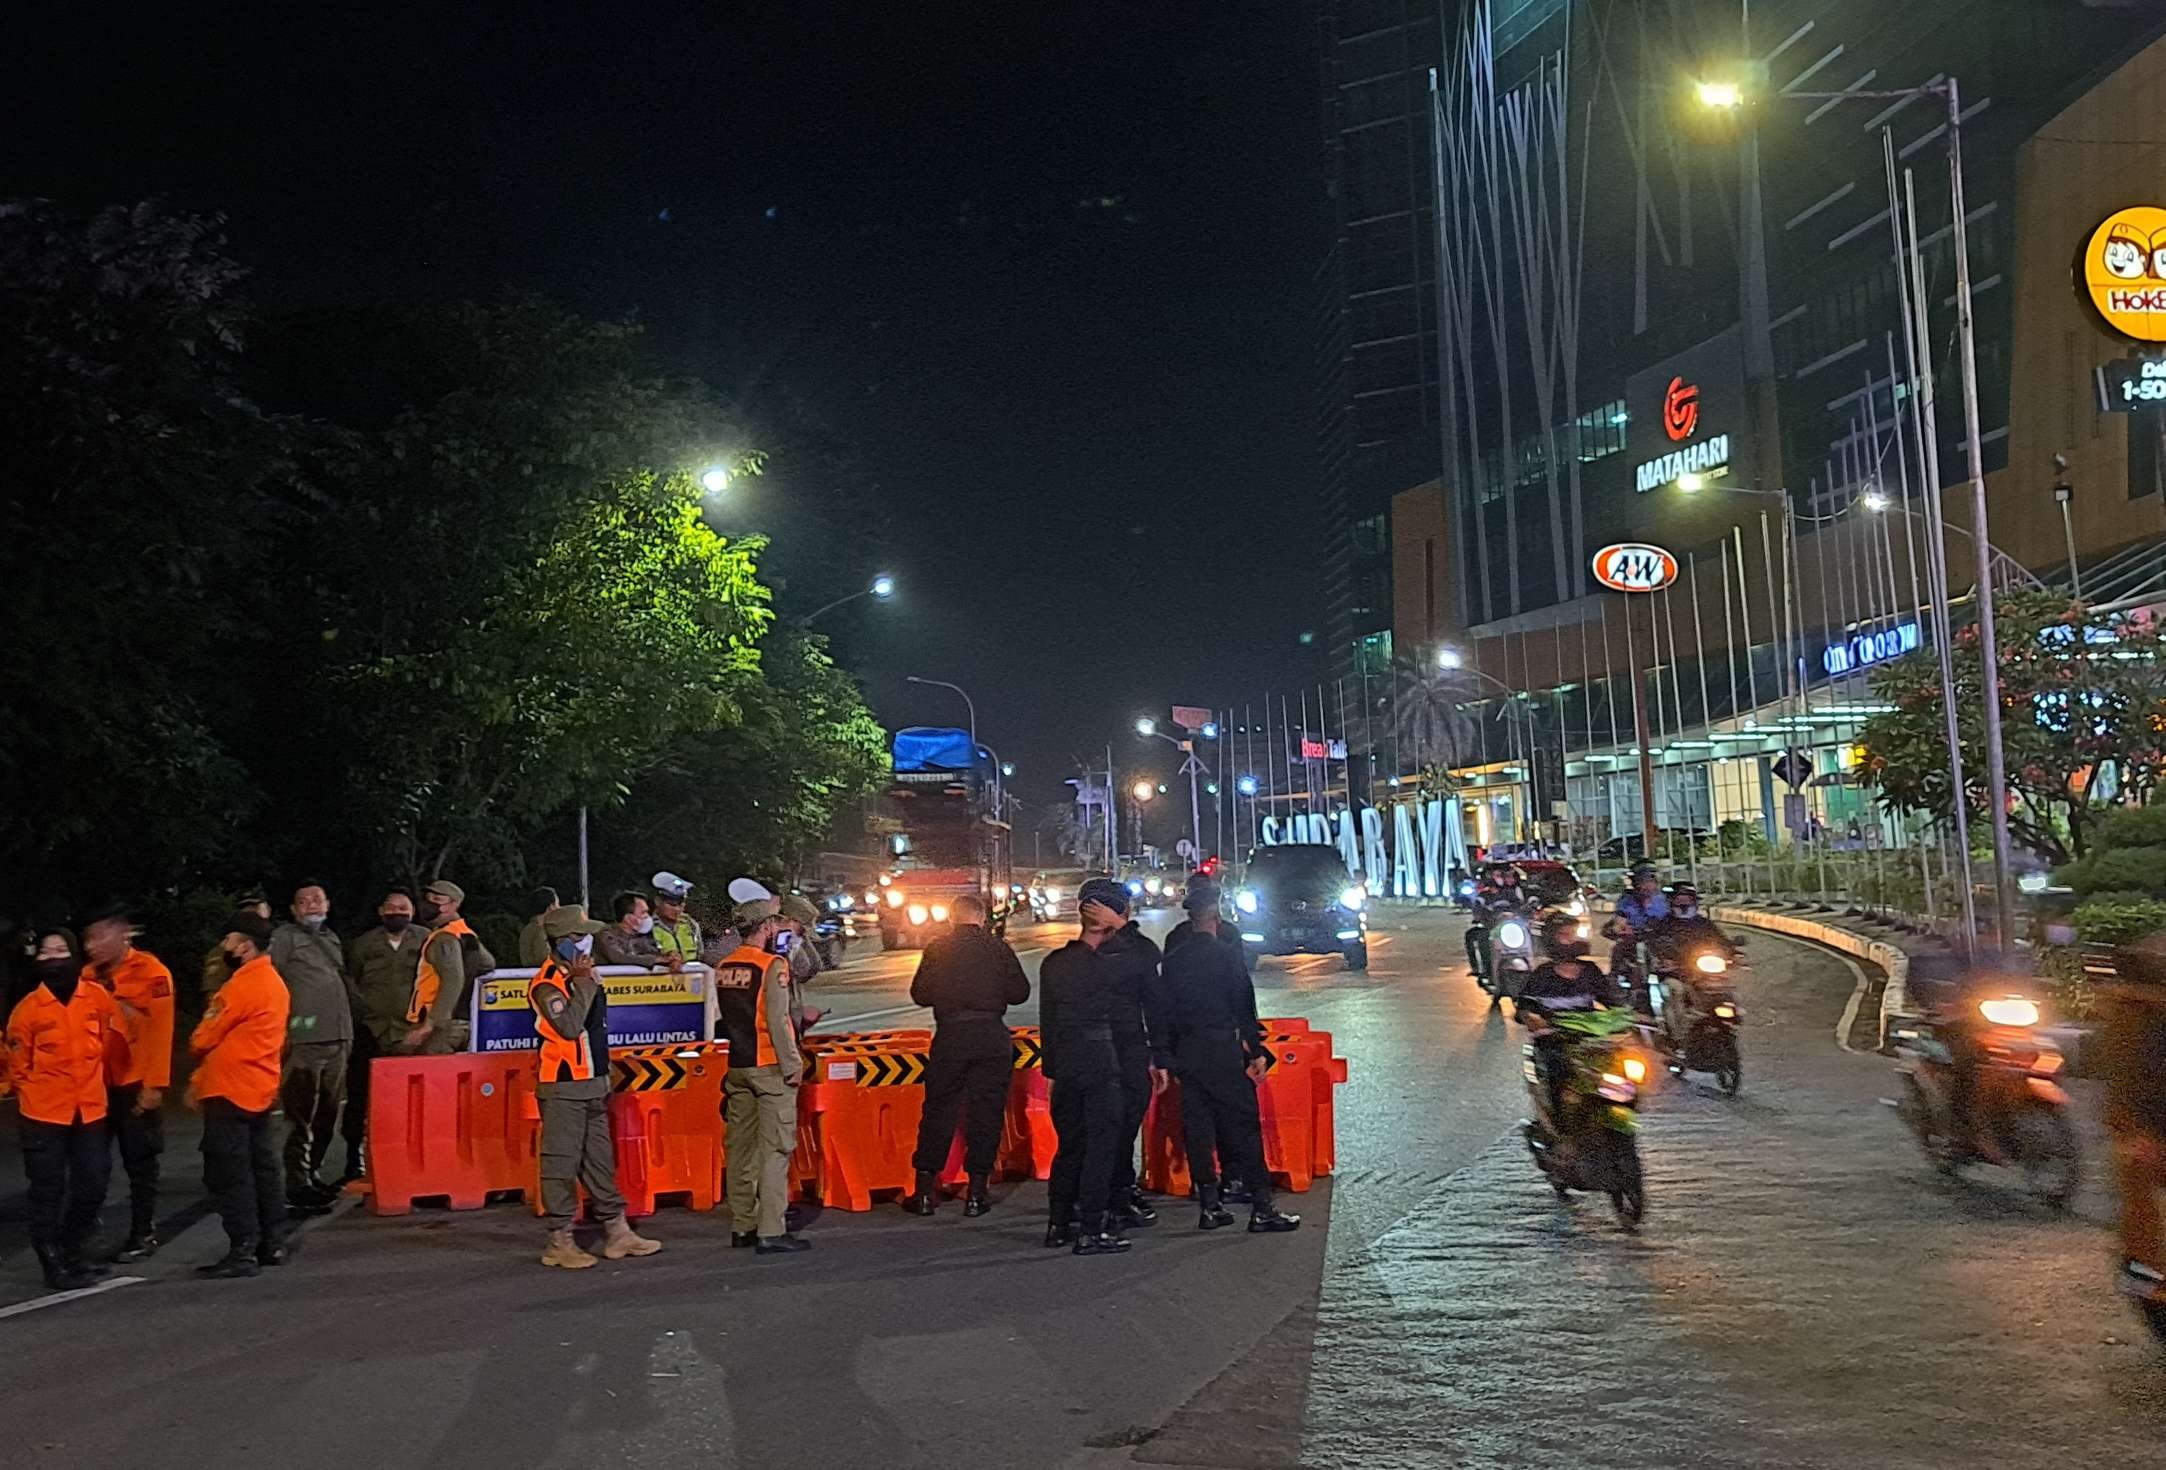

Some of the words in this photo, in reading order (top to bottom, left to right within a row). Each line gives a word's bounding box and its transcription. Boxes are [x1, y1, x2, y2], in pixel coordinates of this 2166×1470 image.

[1637, 434, 1728, 492] MATAHARI
[633, 983, 686, 994] SURABAYA
[486, 1038, 531, 1050] PATUHI
[625, 1032, 656, 1044] LALU
[657, 1030, 697, 1043] LINTAS
